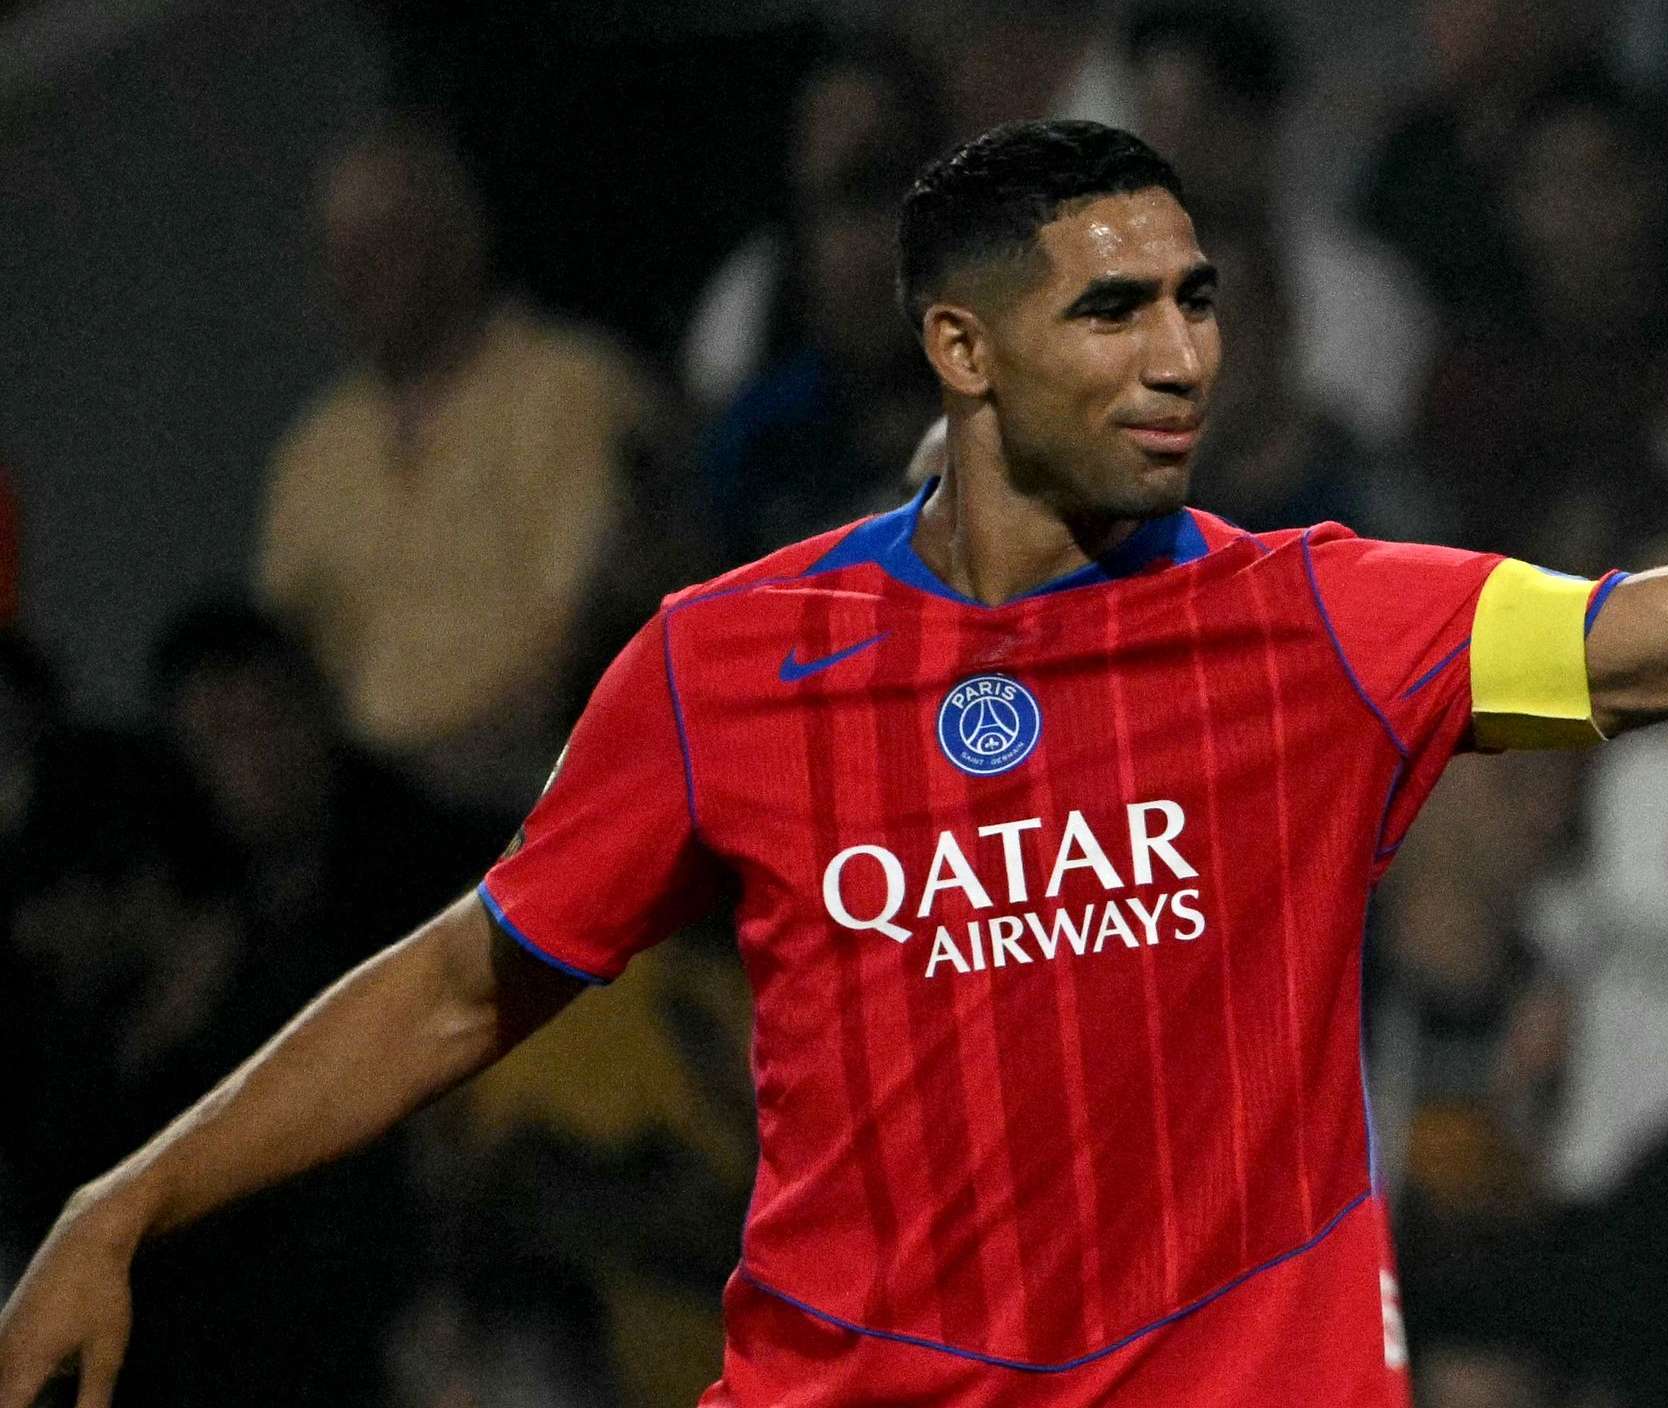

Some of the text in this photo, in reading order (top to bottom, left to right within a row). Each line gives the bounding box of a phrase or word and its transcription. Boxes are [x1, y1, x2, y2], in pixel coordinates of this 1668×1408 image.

[951, 681, 1017, 709] PARIS
[822, 799, 1199, 943] QATAR
[924, 889, 1206, 978] AIRWAYS
